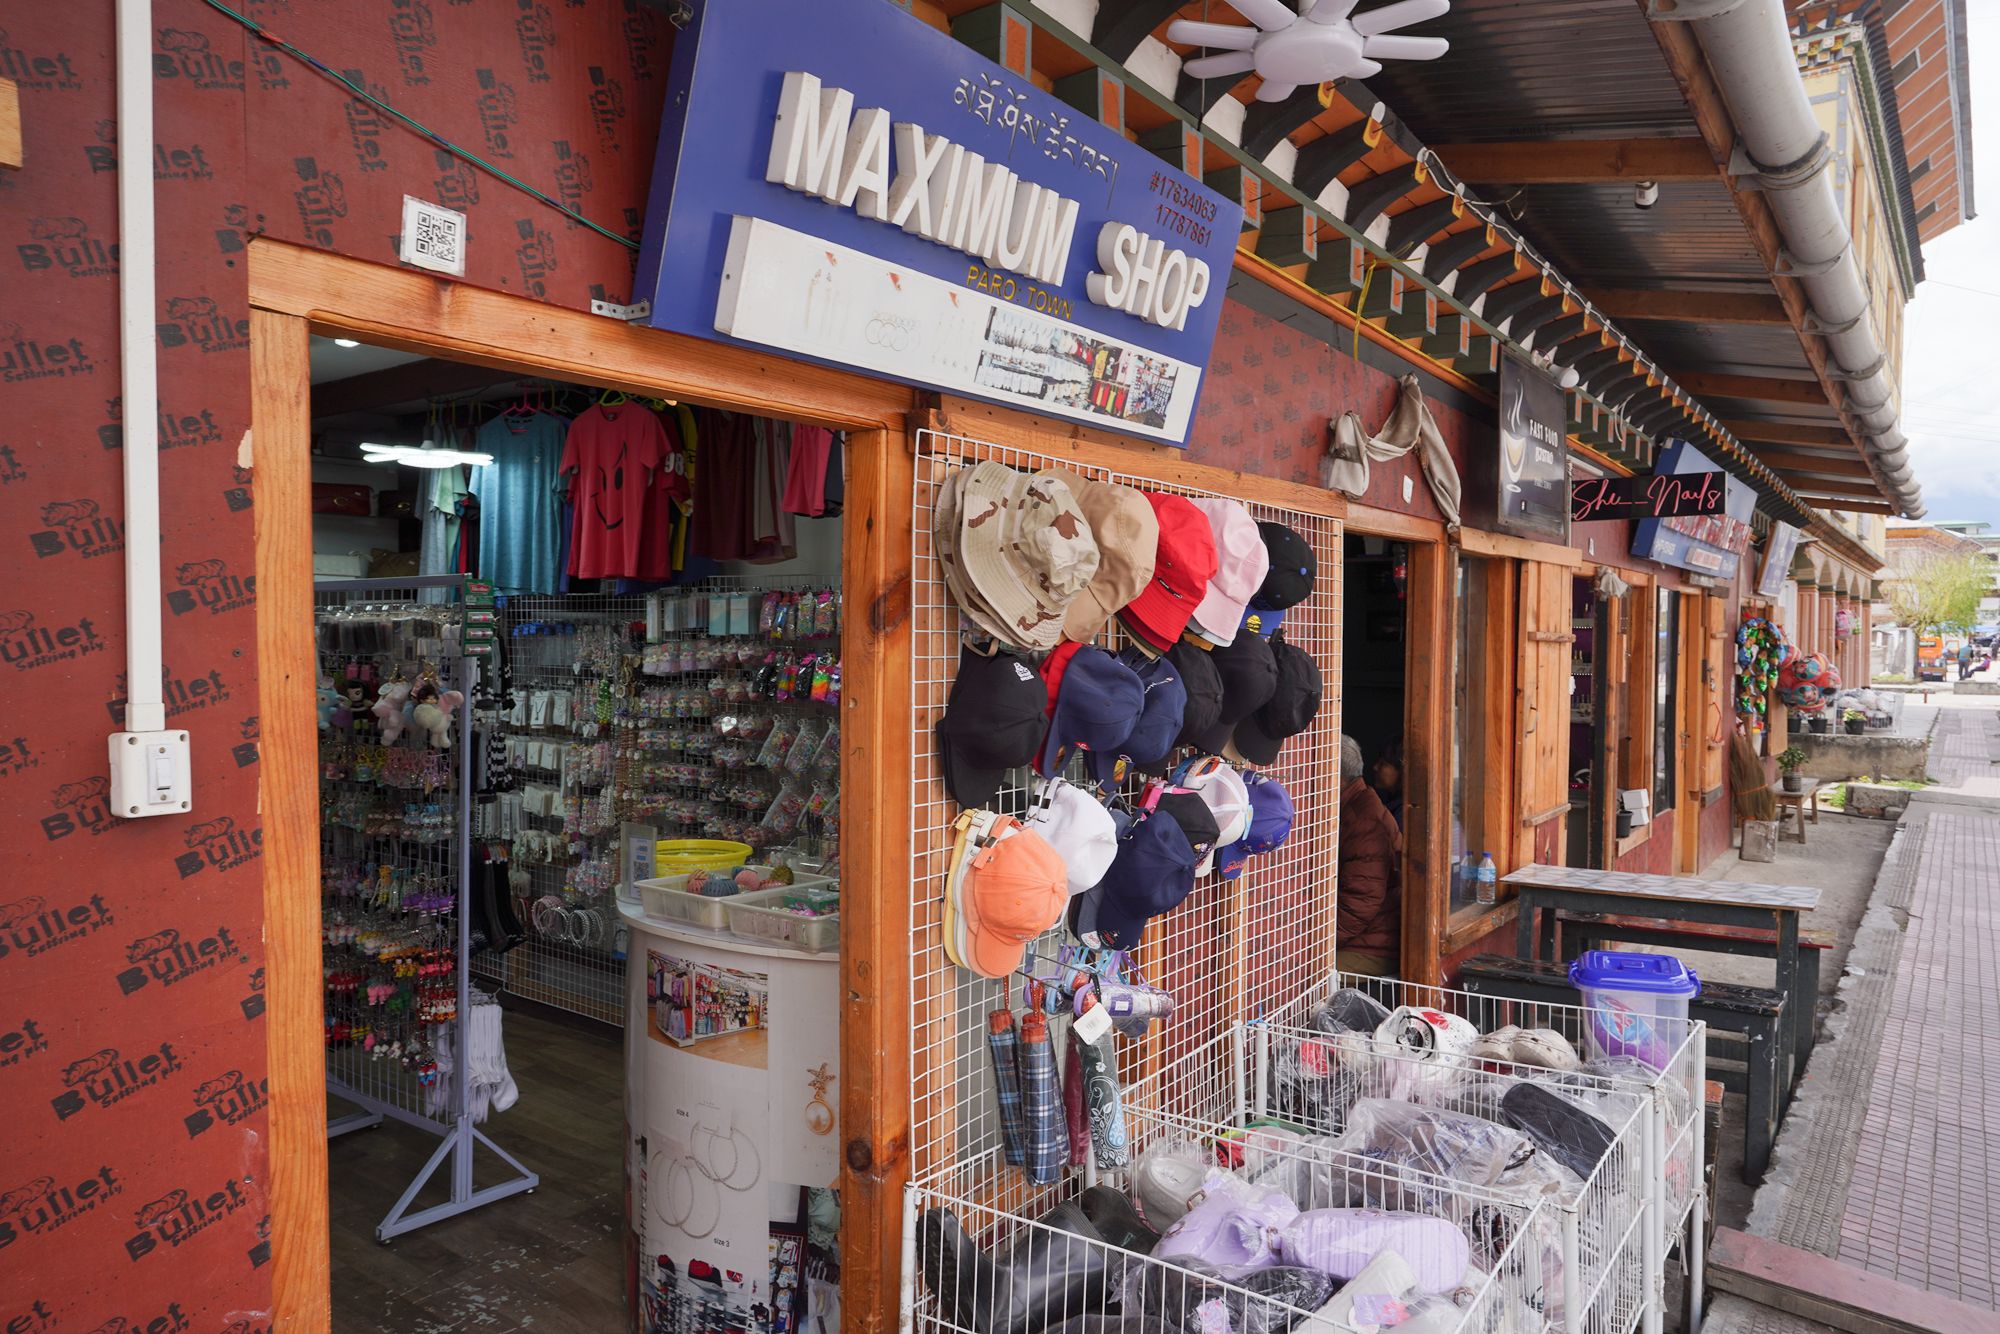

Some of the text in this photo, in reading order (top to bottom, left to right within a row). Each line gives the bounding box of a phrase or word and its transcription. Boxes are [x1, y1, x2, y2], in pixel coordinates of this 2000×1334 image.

[0, 47, 78, 78] llet
[152, 51, 244, 79] Bulle
[553, 140, 582, 218] Bulle
[766, 71, 1210, 331] MAXIMUM SHOP
[295, 157, 334, 248] Bulle
[516, 219, 546, 298] Bulle
[1027, 285, 1073, 320] TOWN
[0, 336, 88, 371] ullet
[156, 315, 249, 348] Bulle
[97, 408, 218, 451] Bllet
[1529, 418, 1544, 441] FAST
[1646, 471, 1721, 517] Nails
[30, 516, 126, 559] Bull
[167, 575, 256, 616] Bulle
[0, 617, 99, 663] ullet
[106, 669, 226, 725] Bllet
[174, 829, 262, 880] Bulle
[116, 926, 235, 996] Bullet
[51, 1042, 178, 1123] Bullet
[184, 1076, 269, 1139] Bull
[125, 1179, 242, 1273] Bullet
[713, 1237, 724, 1247] size
